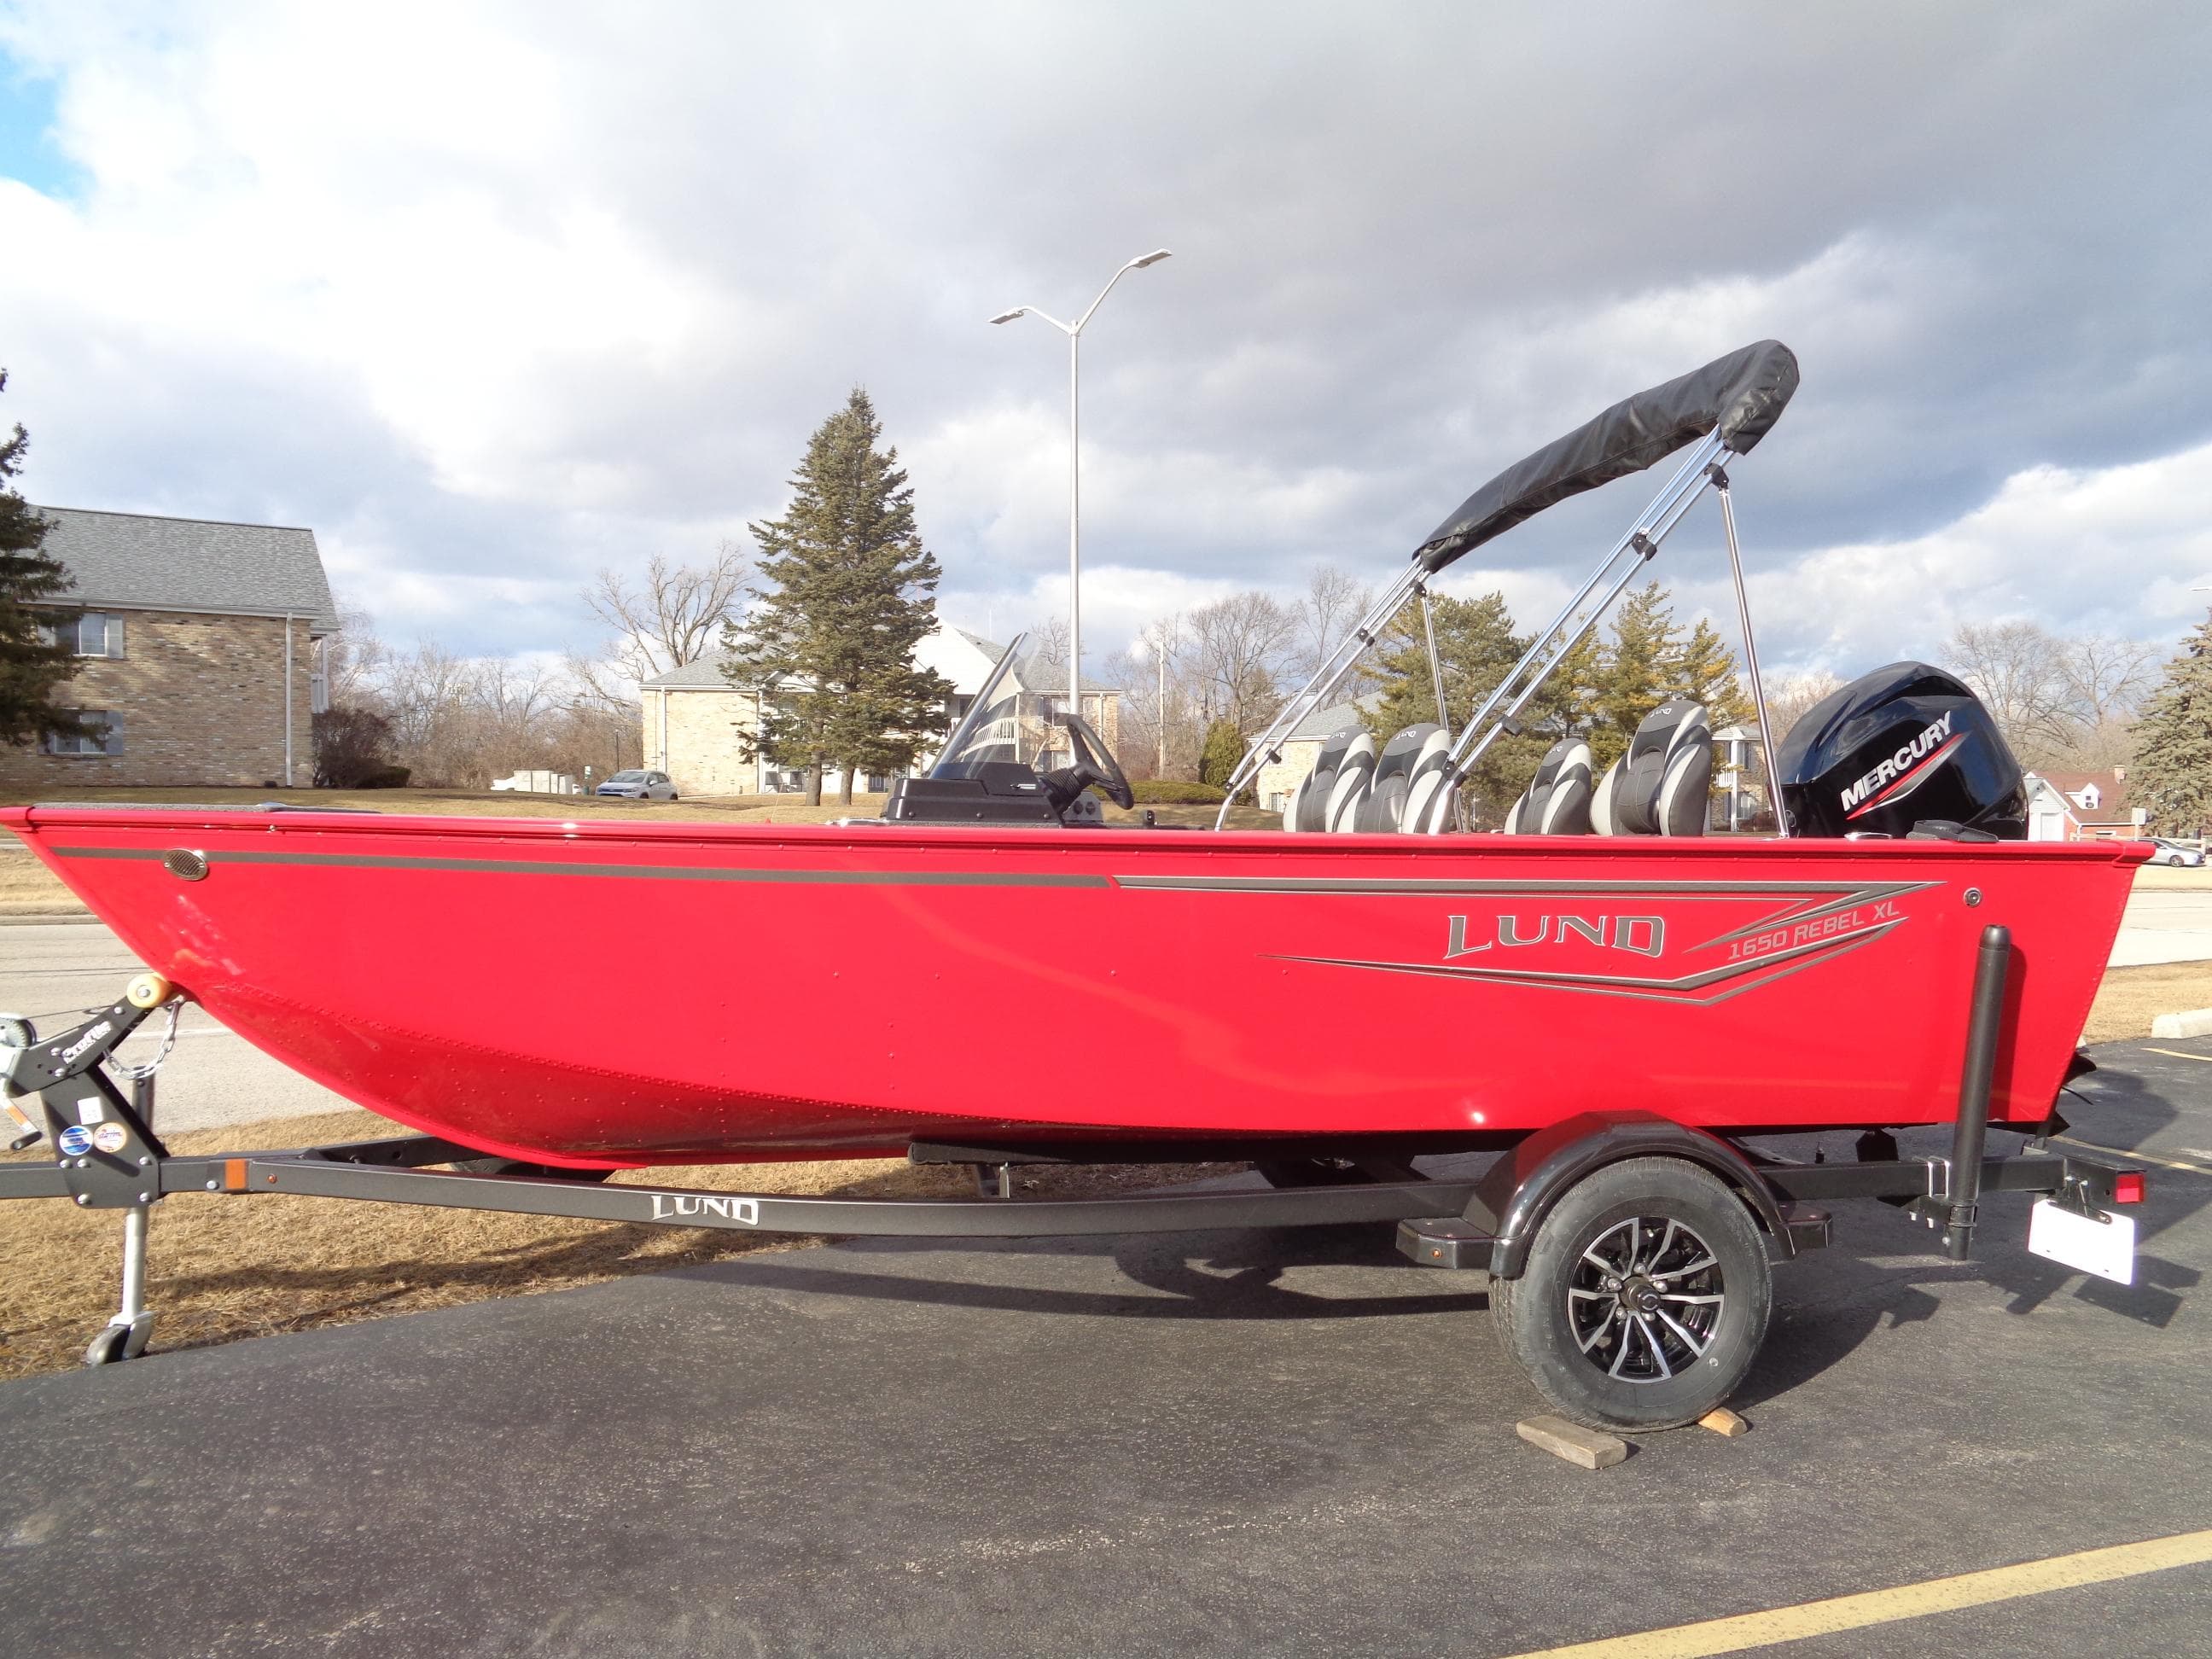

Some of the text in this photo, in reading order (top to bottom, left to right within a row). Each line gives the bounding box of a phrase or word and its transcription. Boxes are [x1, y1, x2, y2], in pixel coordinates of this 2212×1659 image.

[1840, 710, 1953, 812] MERCURY
[1443, 915, 1665, 960] LUND
[1728, 901, 1901, 960] 1650 REBEL XL
[650, 1195, 760, 1225] LUND
